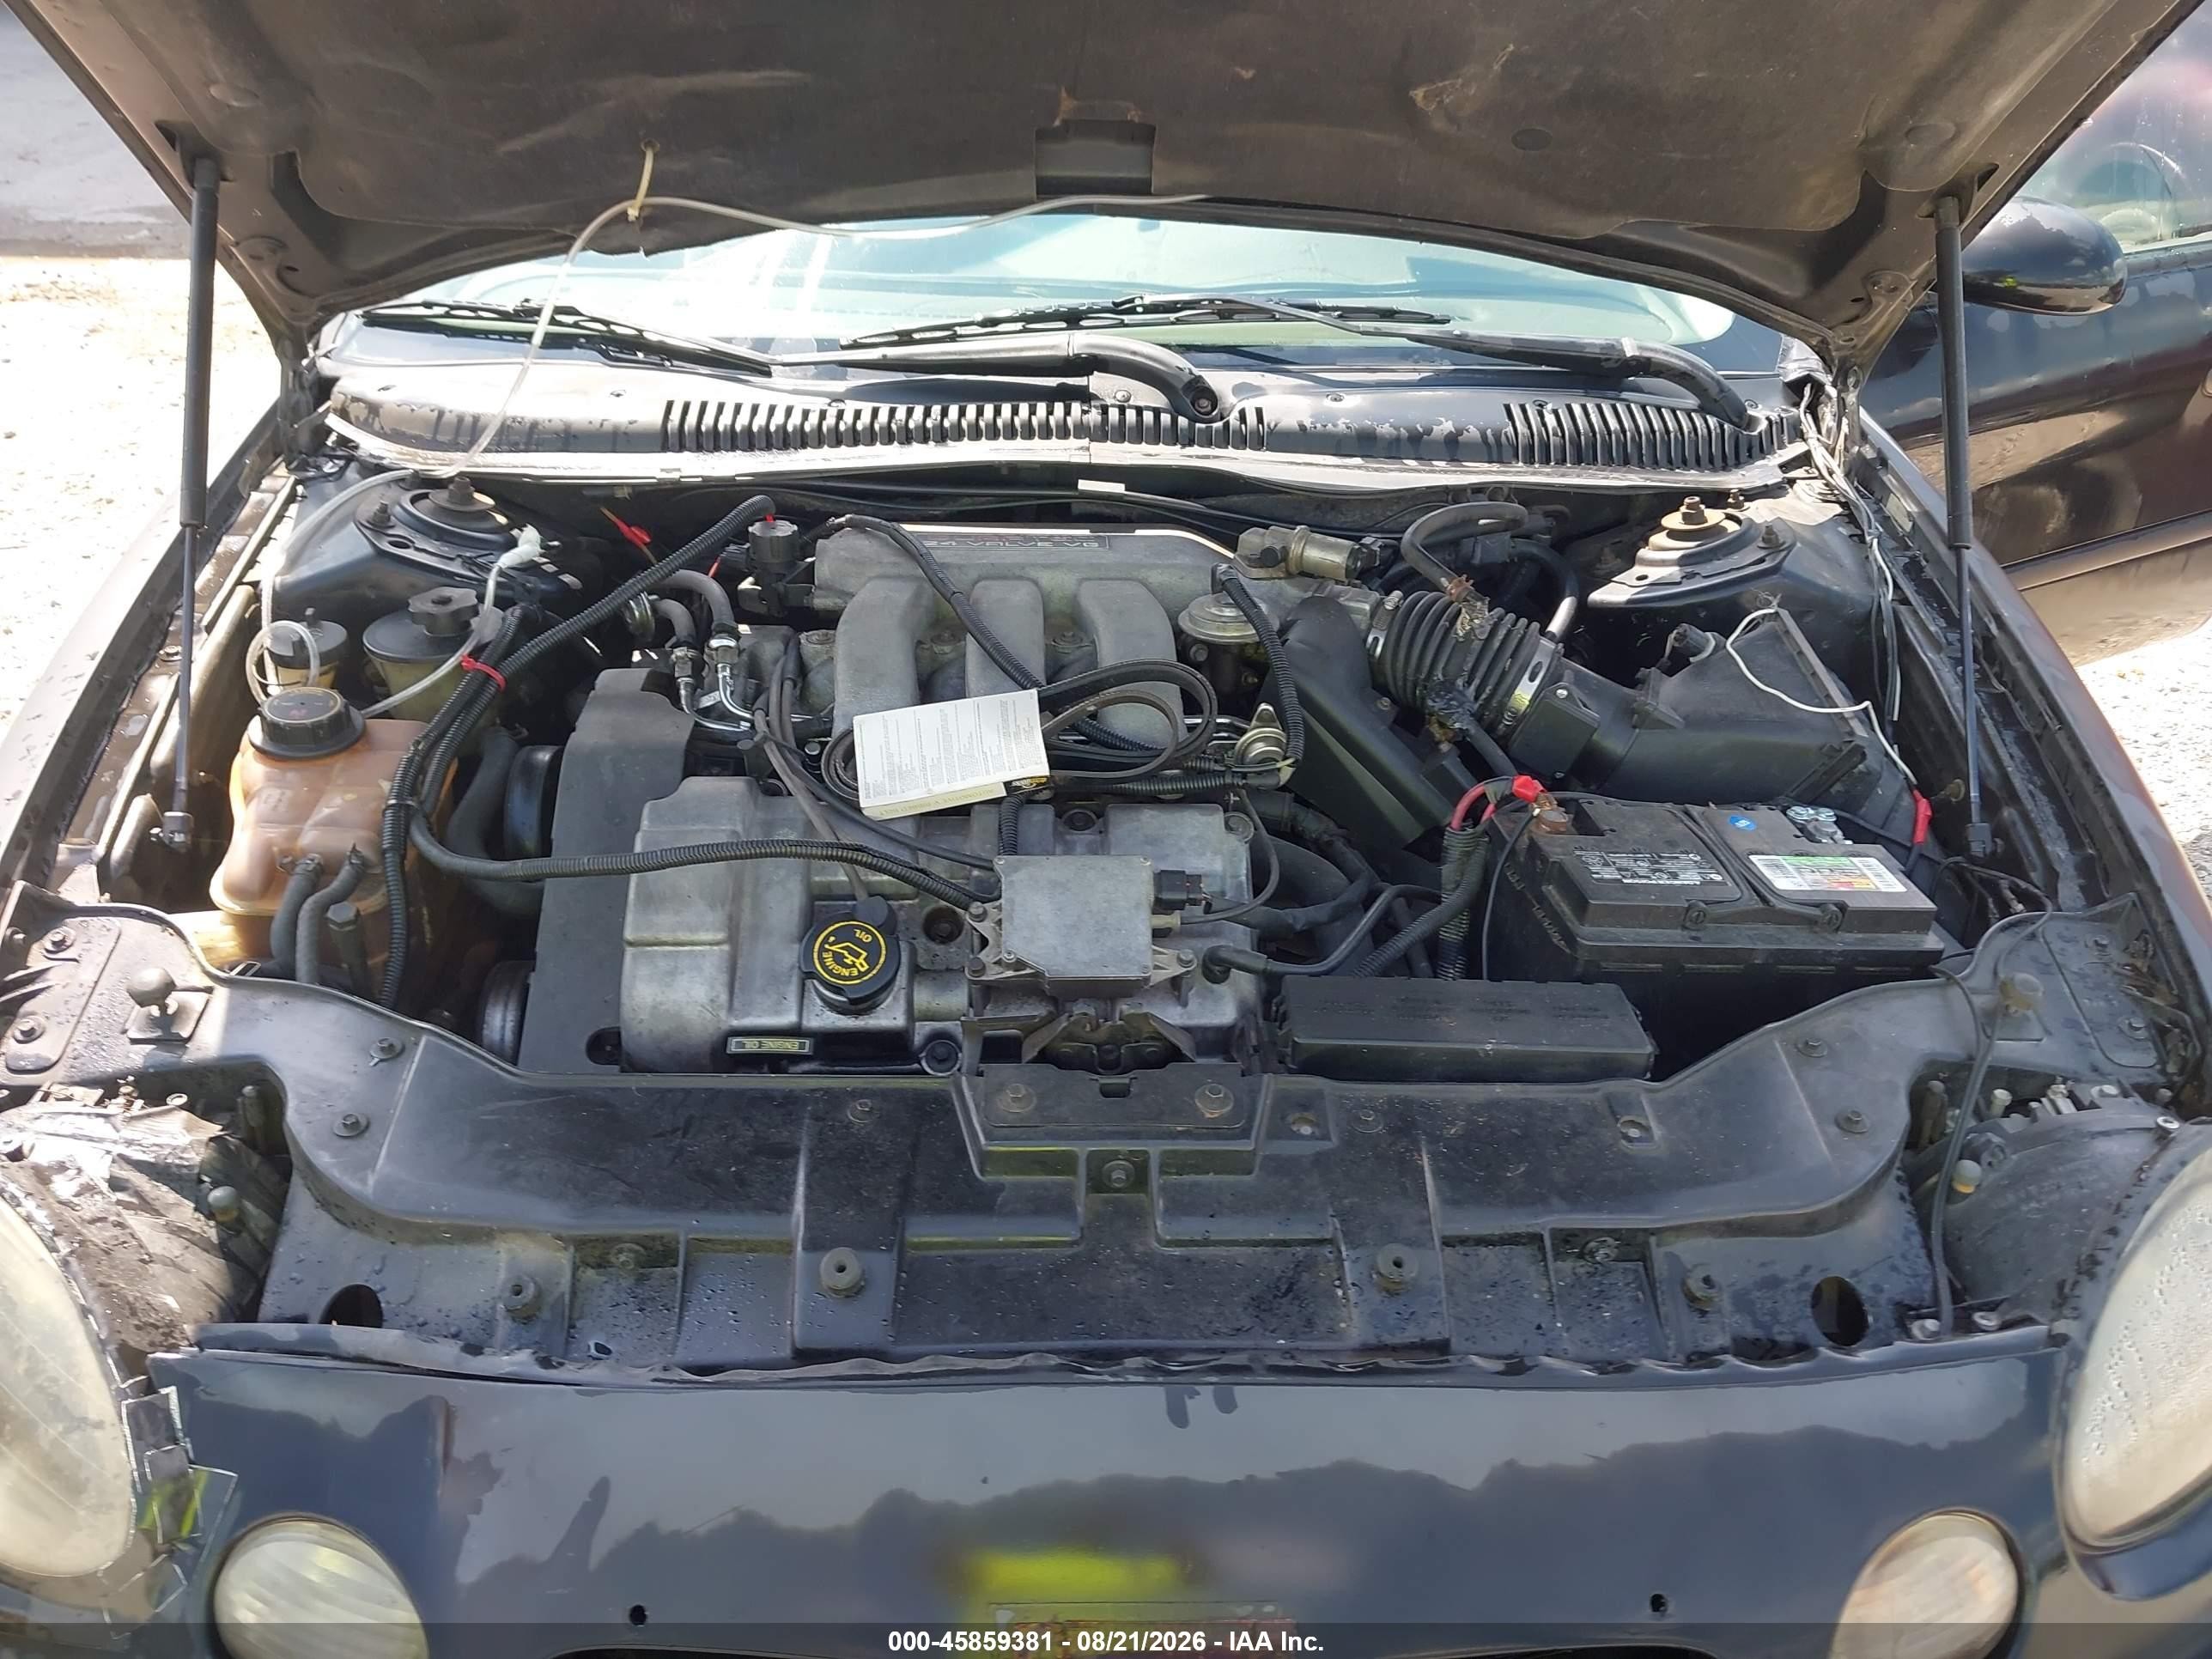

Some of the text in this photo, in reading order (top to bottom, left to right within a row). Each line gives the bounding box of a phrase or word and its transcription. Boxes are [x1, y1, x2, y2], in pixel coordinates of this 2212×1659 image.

[854, 928, 872, 943] OIL
[822, 951, 859, 976] ENGINE
[760, 1041, 798, 1049] ENGINE
